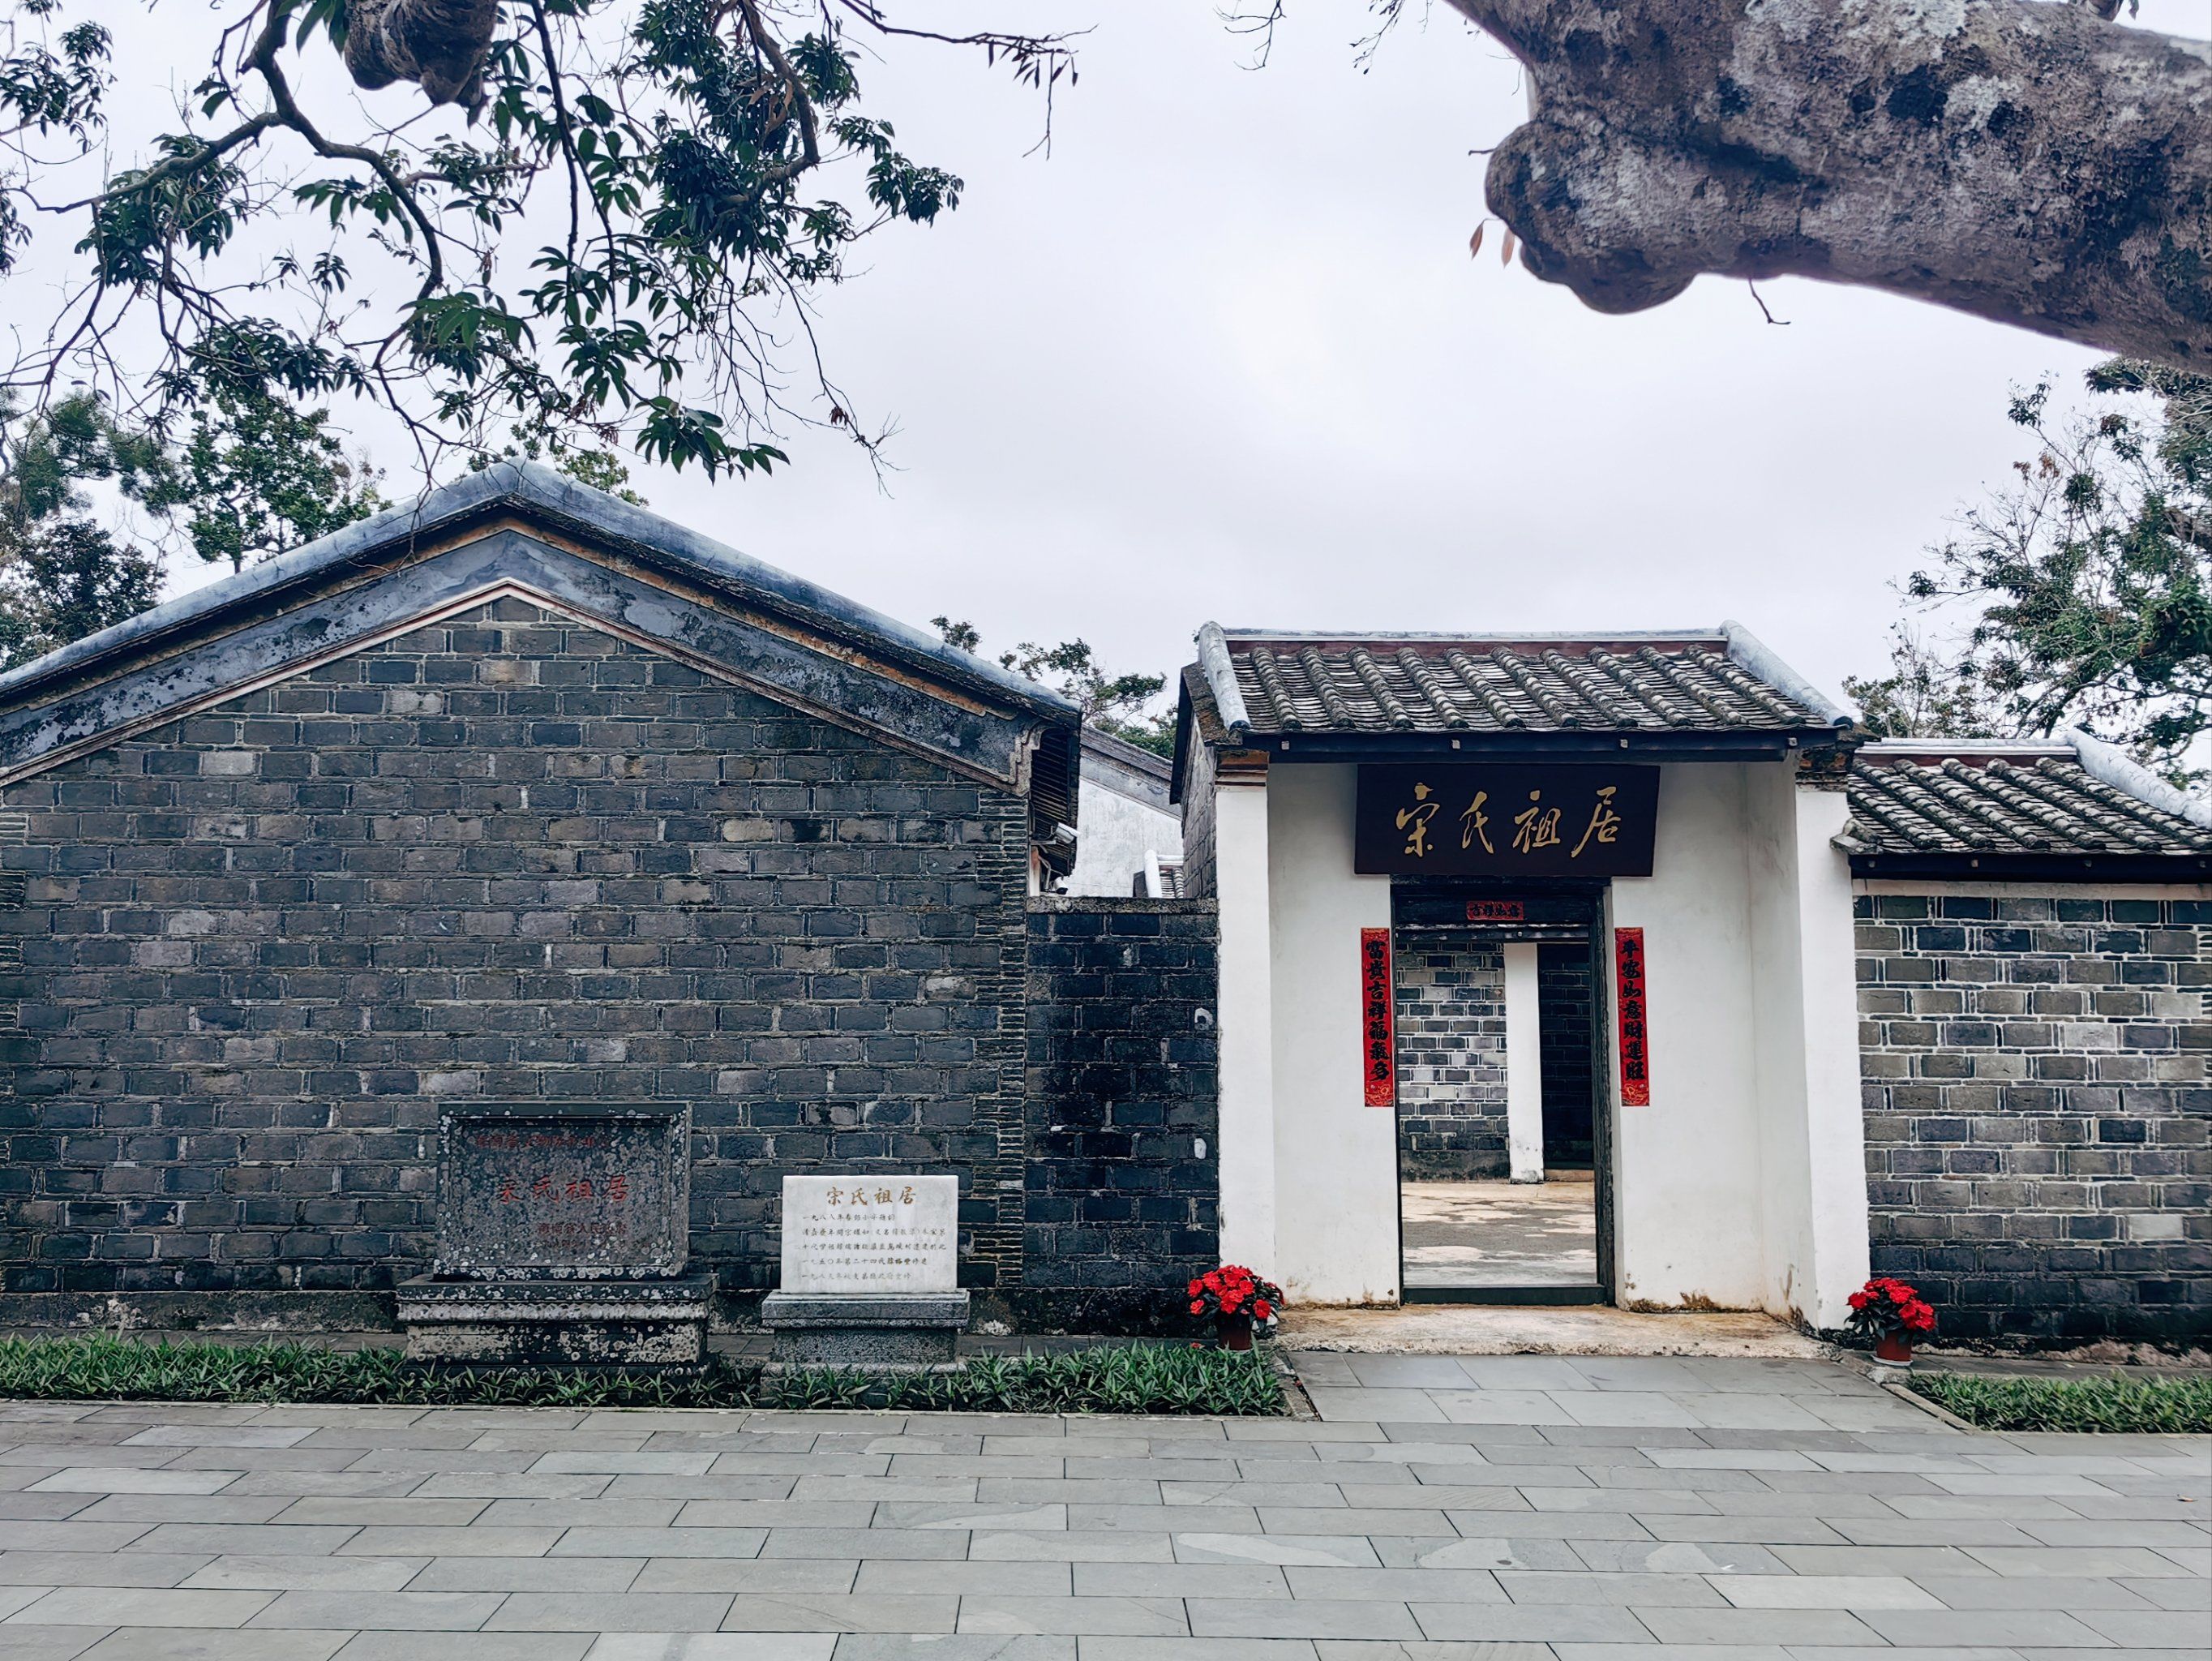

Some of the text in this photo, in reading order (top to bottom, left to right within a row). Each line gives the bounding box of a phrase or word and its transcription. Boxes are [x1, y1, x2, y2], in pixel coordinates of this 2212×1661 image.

[1395, 781, 1623, 859] 宋氏祖居
[1365, 938, 1391, 1083] 富貴吉祥福氣多
[1619, 938, 1646, 1081] 平安如意財運旺
[496, 1174, 630, 1205] 宋氏祖居
[825, 1186, 917, 1207] 宋氏祖居
